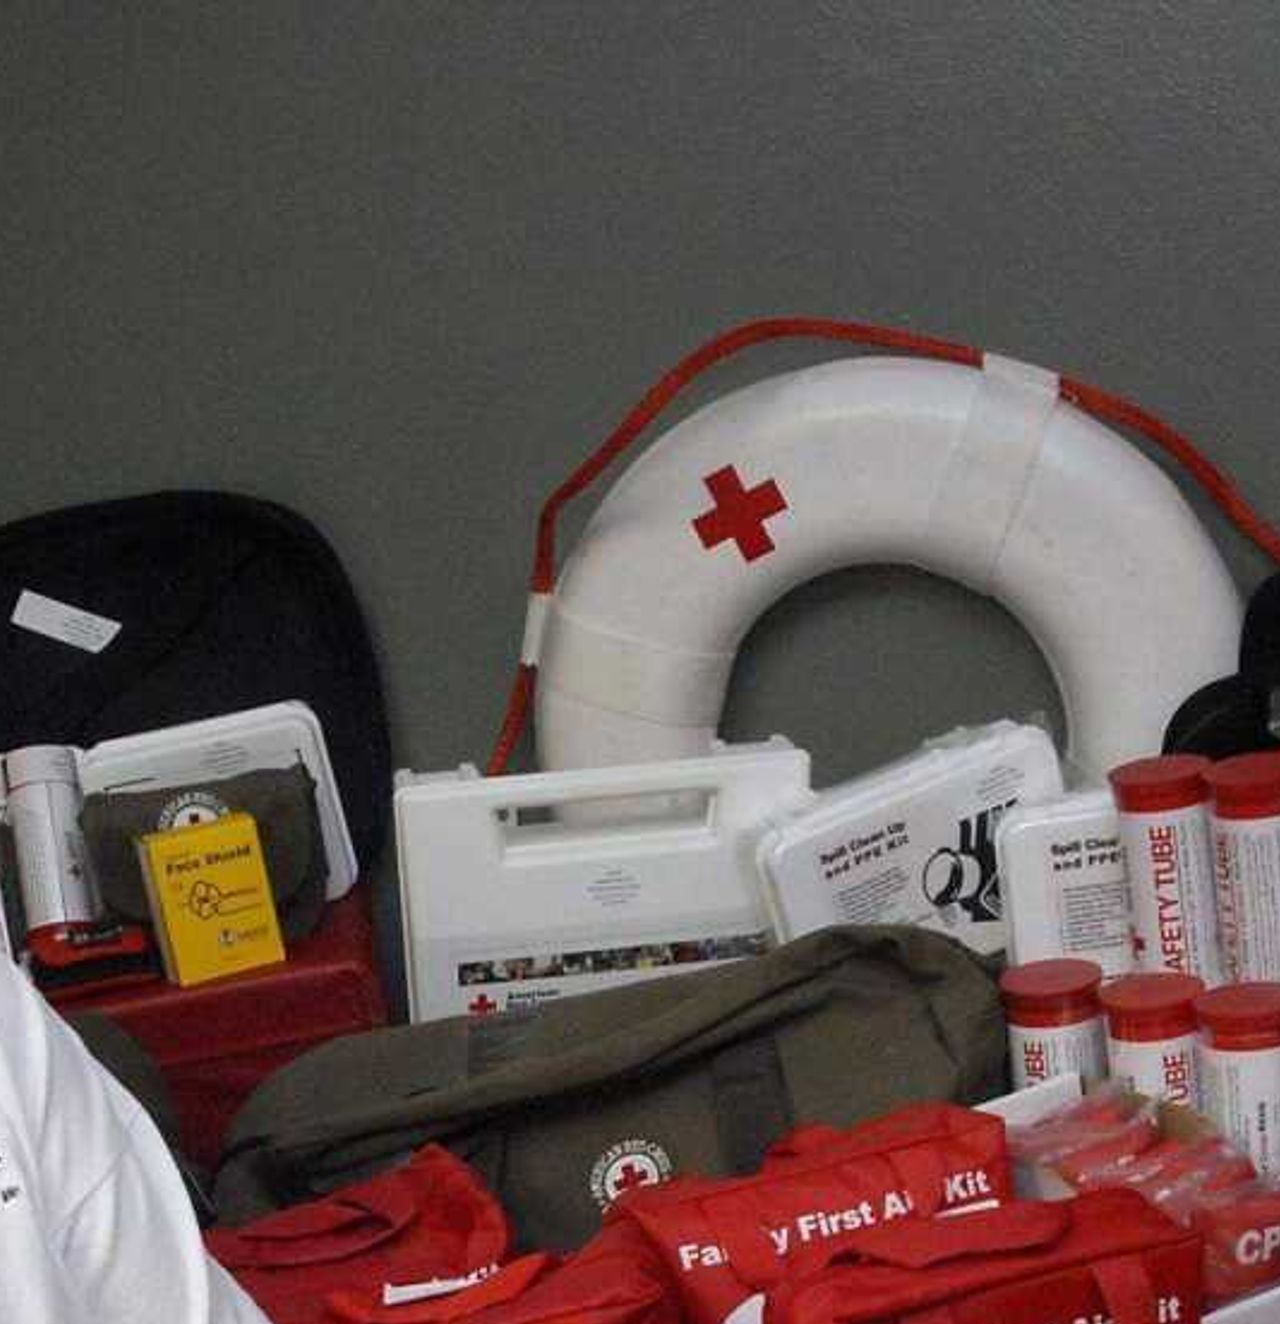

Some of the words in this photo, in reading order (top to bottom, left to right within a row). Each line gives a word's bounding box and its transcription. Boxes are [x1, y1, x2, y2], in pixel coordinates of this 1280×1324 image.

[1148, 825, 1178, 890] TUBE
[1158, 896, 1187, 971] AFETY
[1163, 1055, 1190, 1101] UBE
[796, 1201, 876, 1243] First
[944, 1168, 991, 1203] Kit
[1158, 1297, 1181, 1324] it
